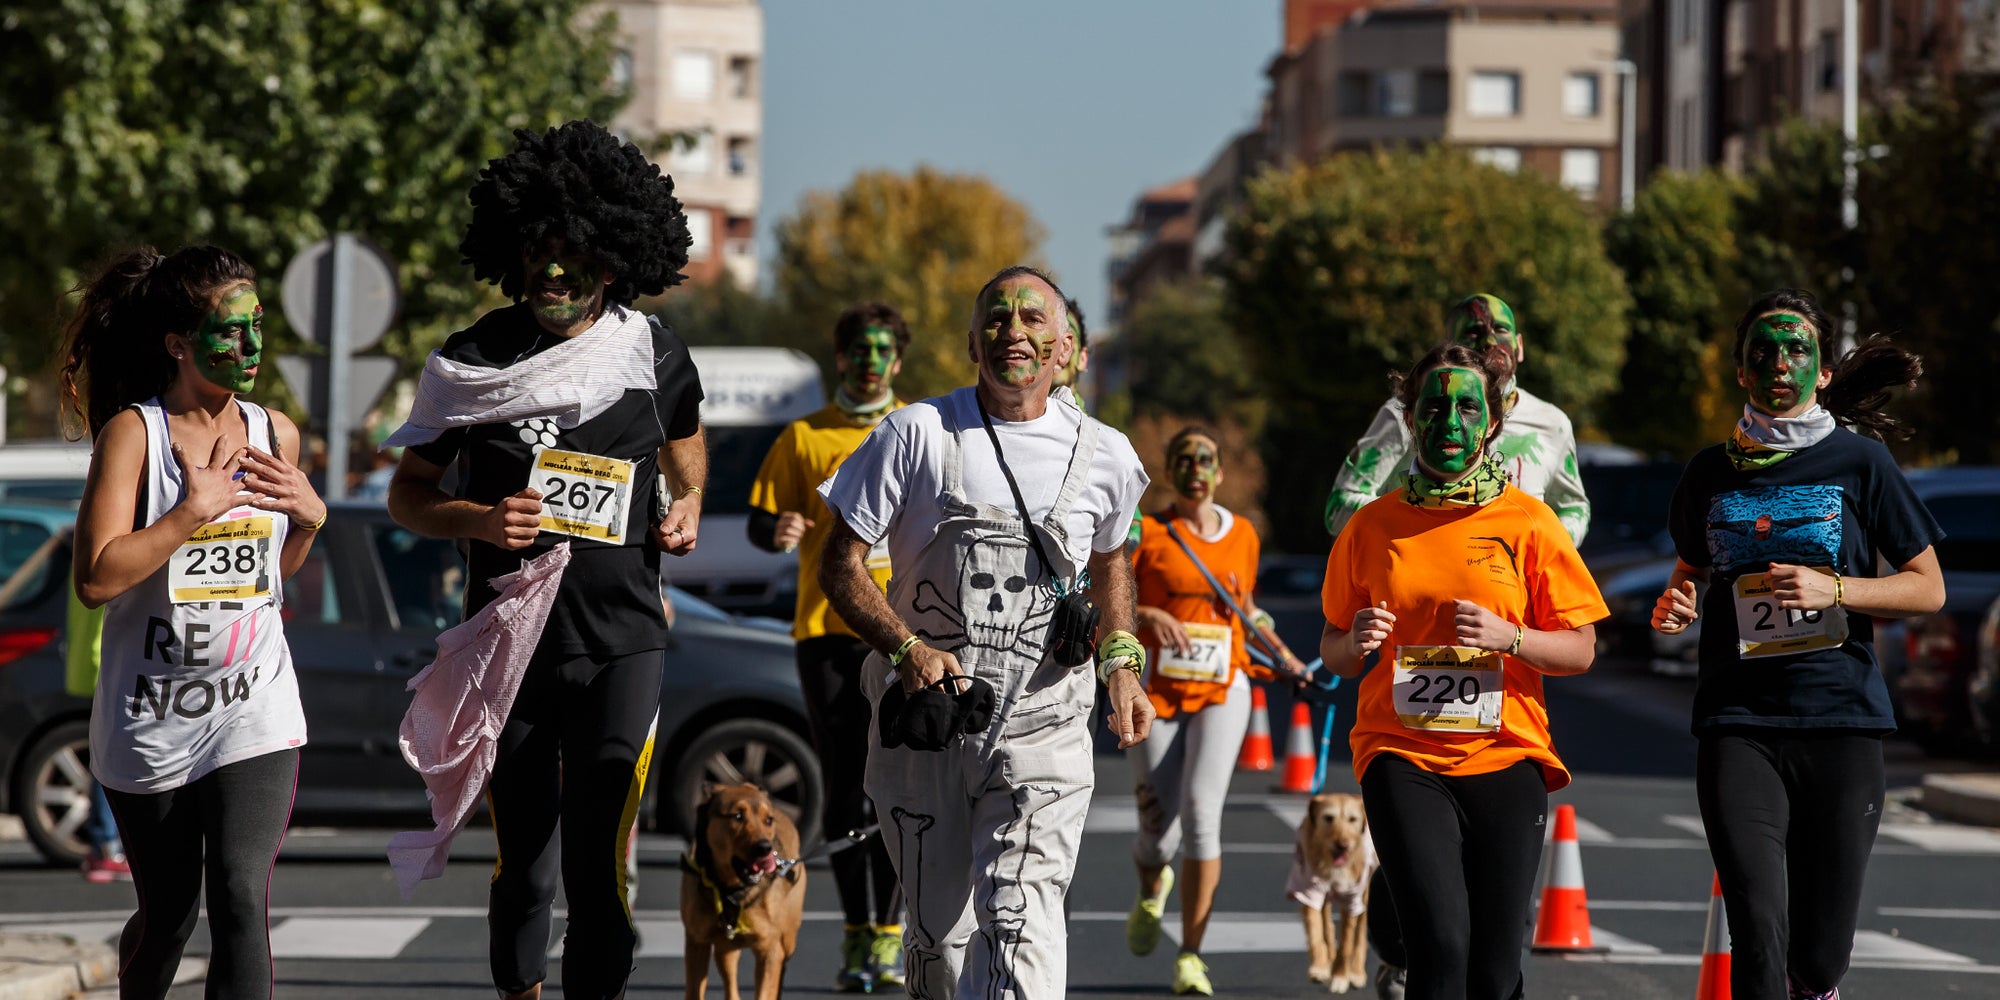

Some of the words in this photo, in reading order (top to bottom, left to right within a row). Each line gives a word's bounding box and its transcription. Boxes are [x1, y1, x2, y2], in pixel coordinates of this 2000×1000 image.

[544, 462, 572, 471] NUCLEAR
[541, 477, 615, 514] 267
[185, 544, 256, 576] 238
[1407, 674, 1480, 706] 220
